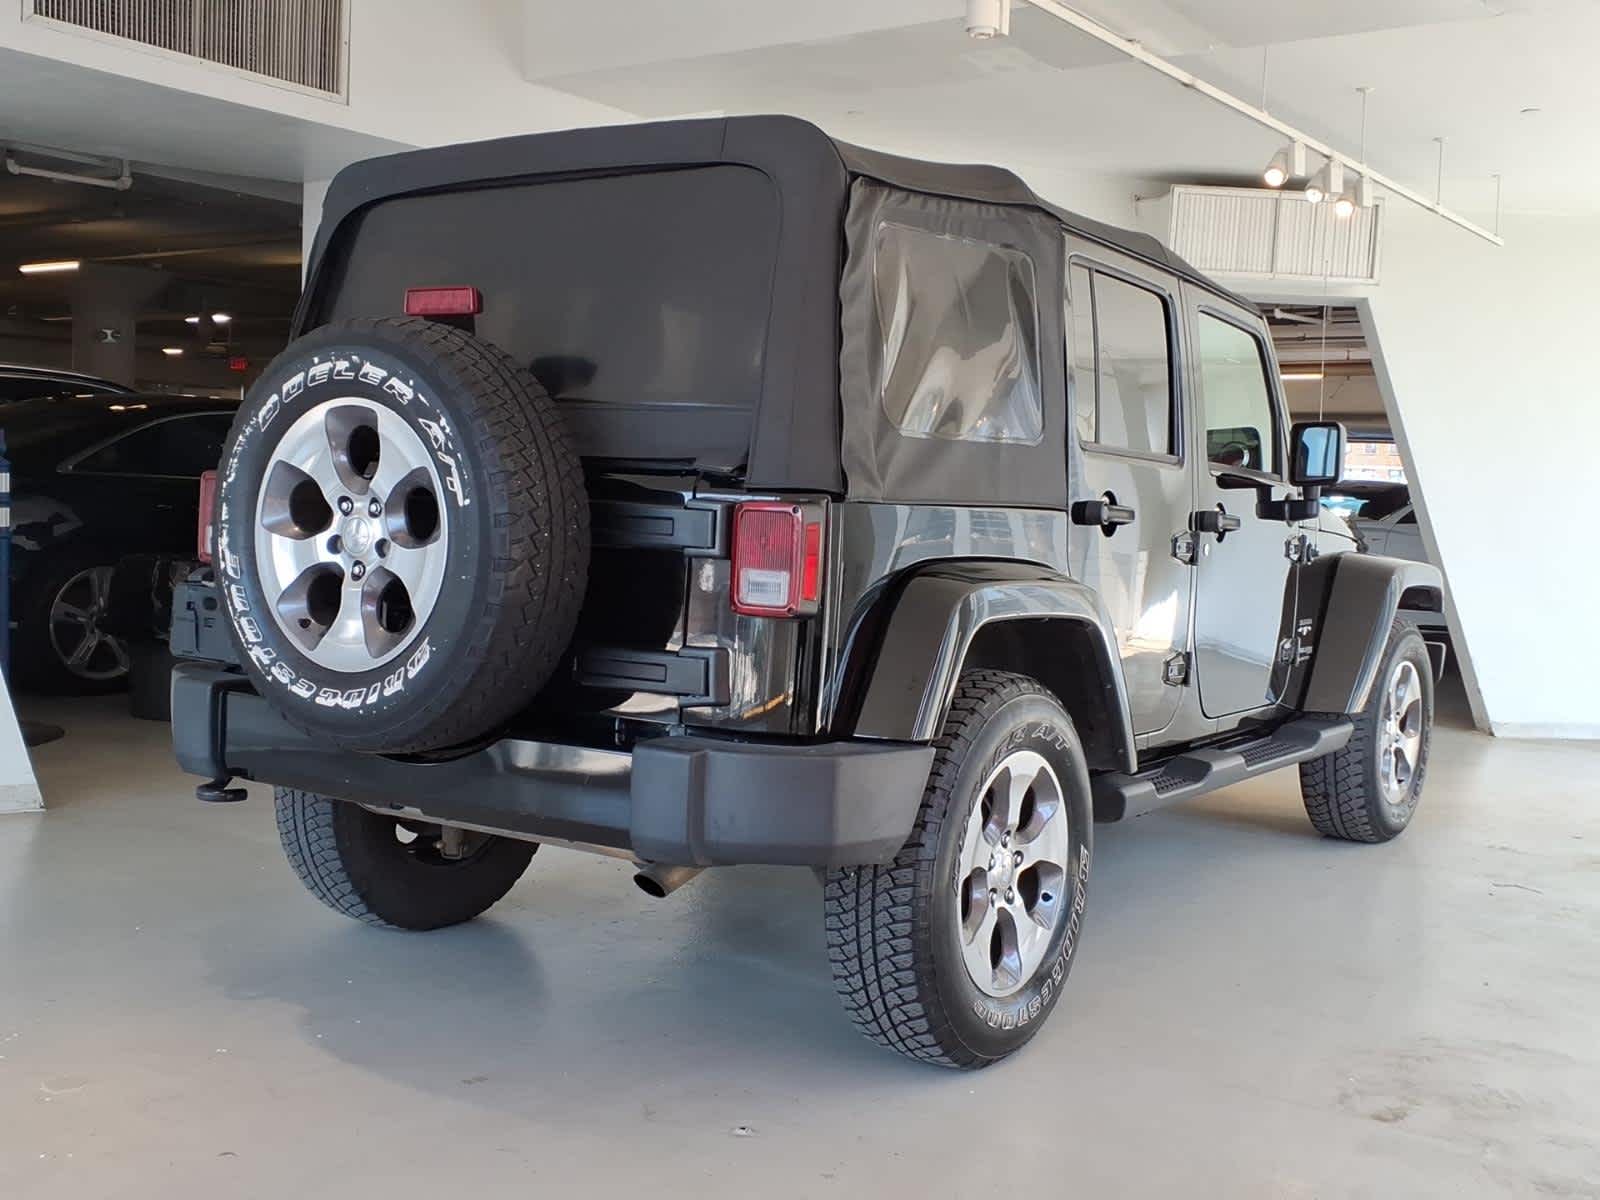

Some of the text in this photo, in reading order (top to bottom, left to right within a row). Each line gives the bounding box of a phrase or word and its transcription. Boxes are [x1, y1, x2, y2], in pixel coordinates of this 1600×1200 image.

[258, 357, 467, 507] DUELER A/T
[220, 550, 432, 709] BRIDGESTONE
[1032, 723, 1069, 751] A/T
[973, 843, 1090, 1030] BRIDGESTONE
